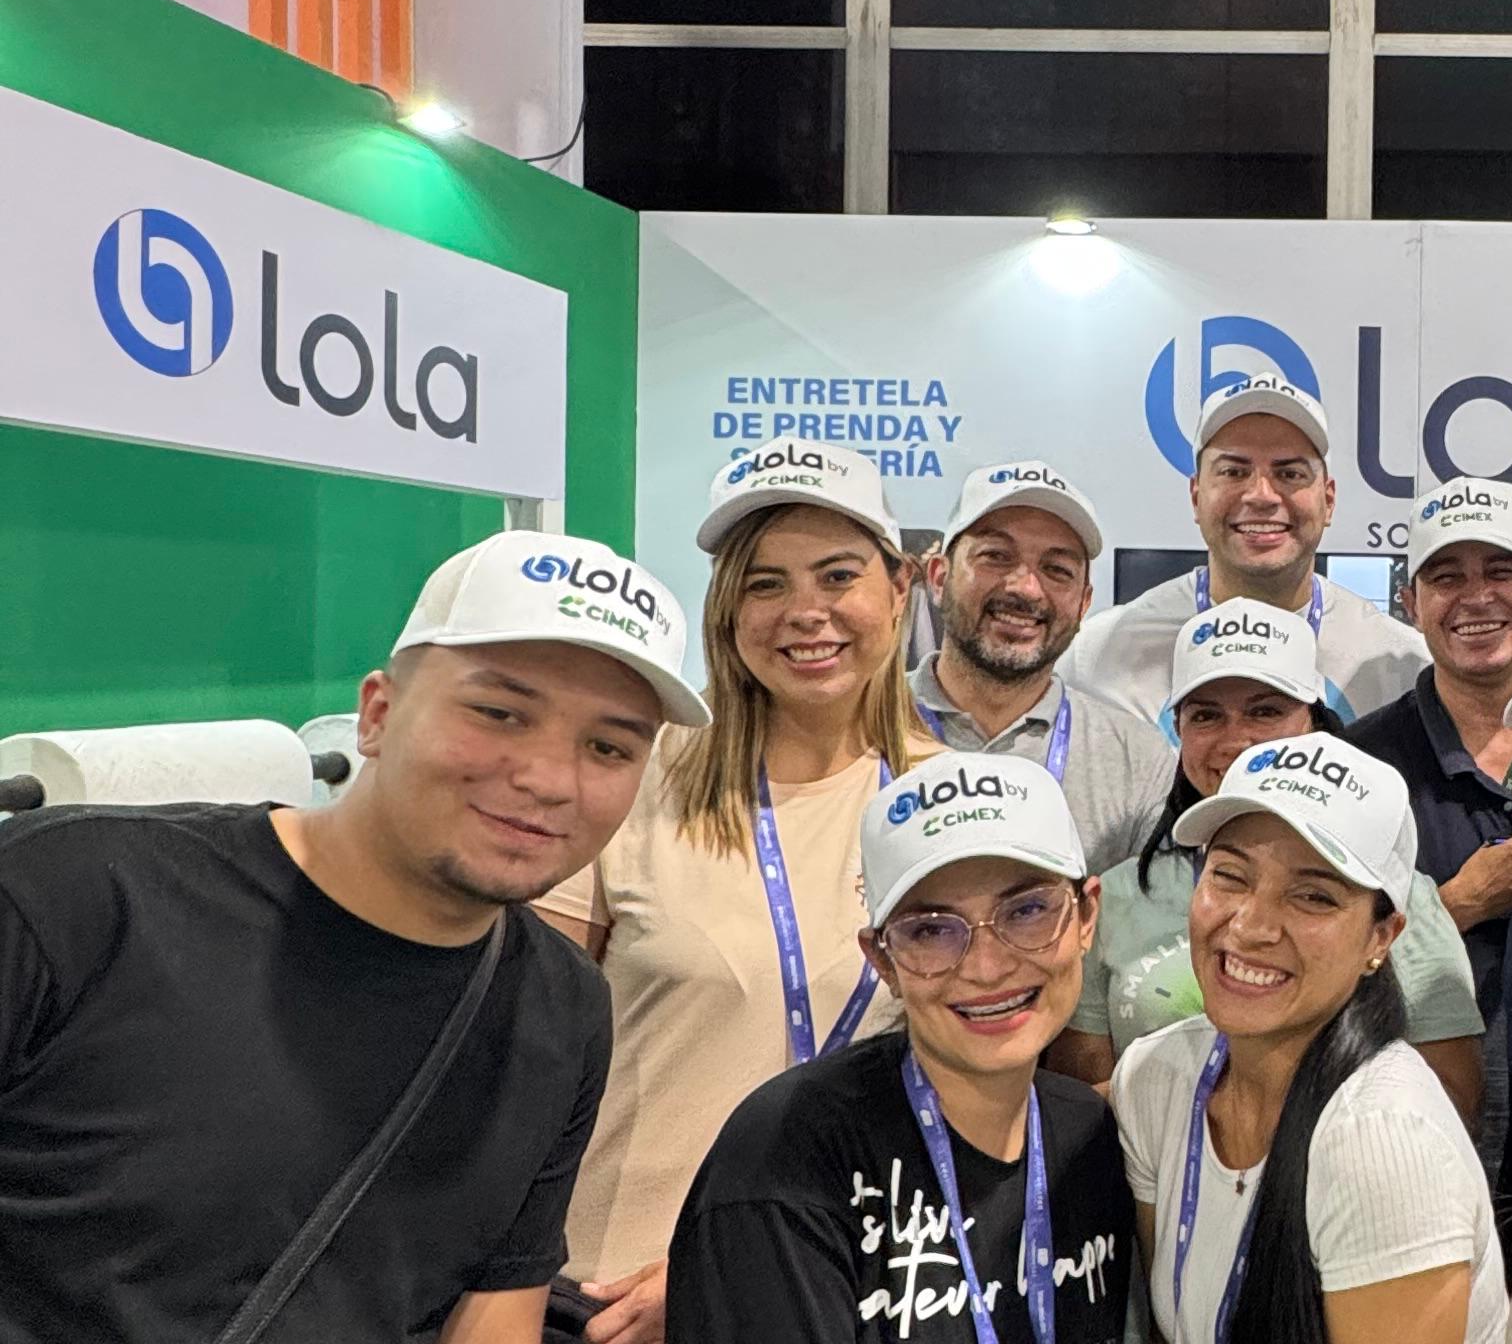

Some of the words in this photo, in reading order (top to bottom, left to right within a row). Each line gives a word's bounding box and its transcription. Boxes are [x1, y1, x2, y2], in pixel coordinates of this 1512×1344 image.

[261, 249, 477, 443] lola
[727, 377, 948, 406] ENTRETELA
[713, 412, 762, 438] DE
[773, 413, 929, 441] PRENDA
[939, 415, 962, 442] Y
[753, 443, 823, 473] lola
[1442, 485, 1491, 510] lola
[569, 557, 656, 622] lola
[656, 606, 671, 635] by
[1213, 613, 1270, 639] lola
[1272, 745, 1349, 788] lola
[1346, 775, 1370, 800] by
[919, 767, 1003, 810] lola
[1004, 780, 1028, 801] by
